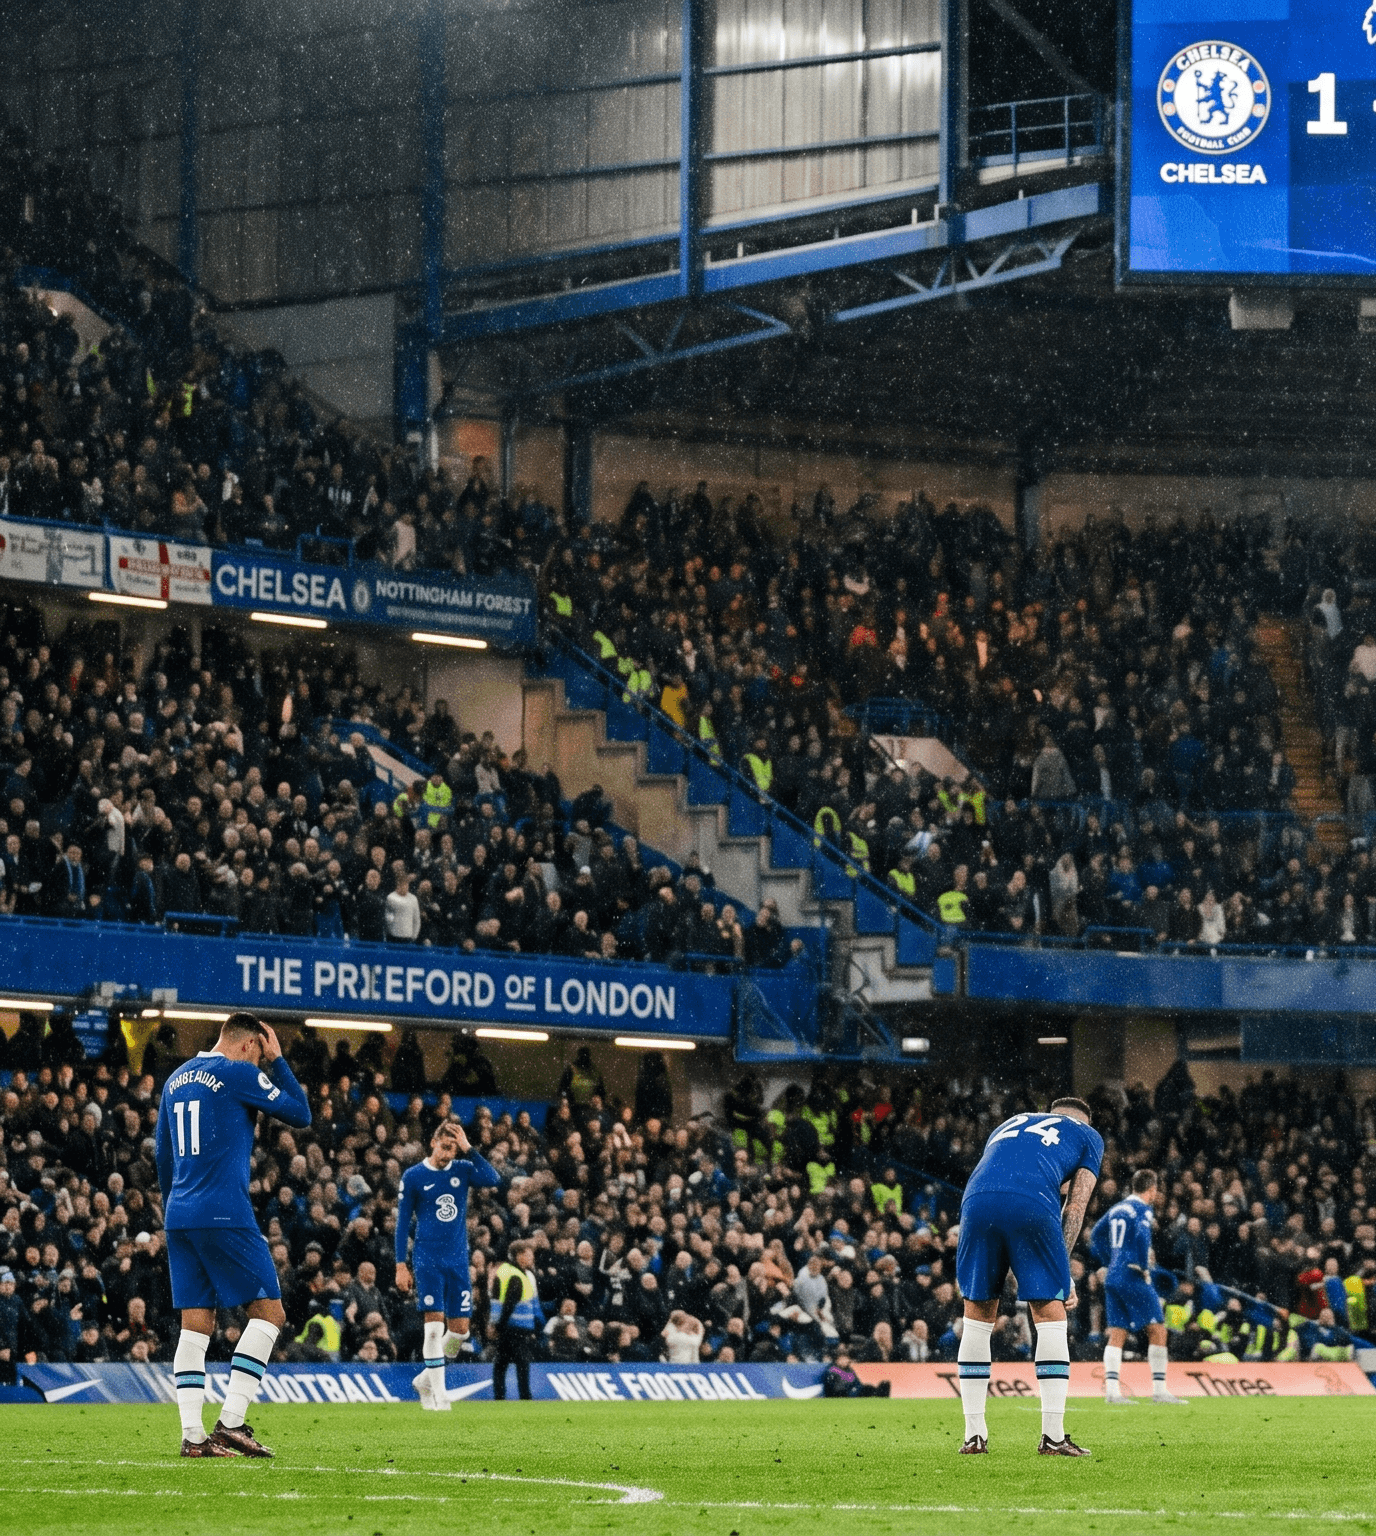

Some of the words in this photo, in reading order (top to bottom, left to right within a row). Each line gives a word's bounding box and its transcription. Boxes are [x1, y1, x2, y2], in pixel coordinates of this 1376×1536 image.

[1176, 44, 1250, 73] CHELSEA
[1306, 72, 1347, 135] 1
[1160, 163, 1267, 184] CHELSEA
[216, 564, 347, 611] CHELSEA
[376, 579, 473, 608] NOTTINGHAM
[475, 592, 532, 615] FOREST
[236, 955, 301, 996] THE
[504, 974, 537, 1000] OF
[545, 977, 676, 1020] LONDON
[173, 1100, 200, 1156] 11
[987, 1115, 1062, 1147] 24
[1111, 1218, 1127, 1248] 17
[250, 1372, 400, 1403] OOTBALL
[546, 1372, 626, 1401] NIKE
[618, 1372, 768, 1401] FOOTBALL
[1184, 1371, 1276, 1396] Three
